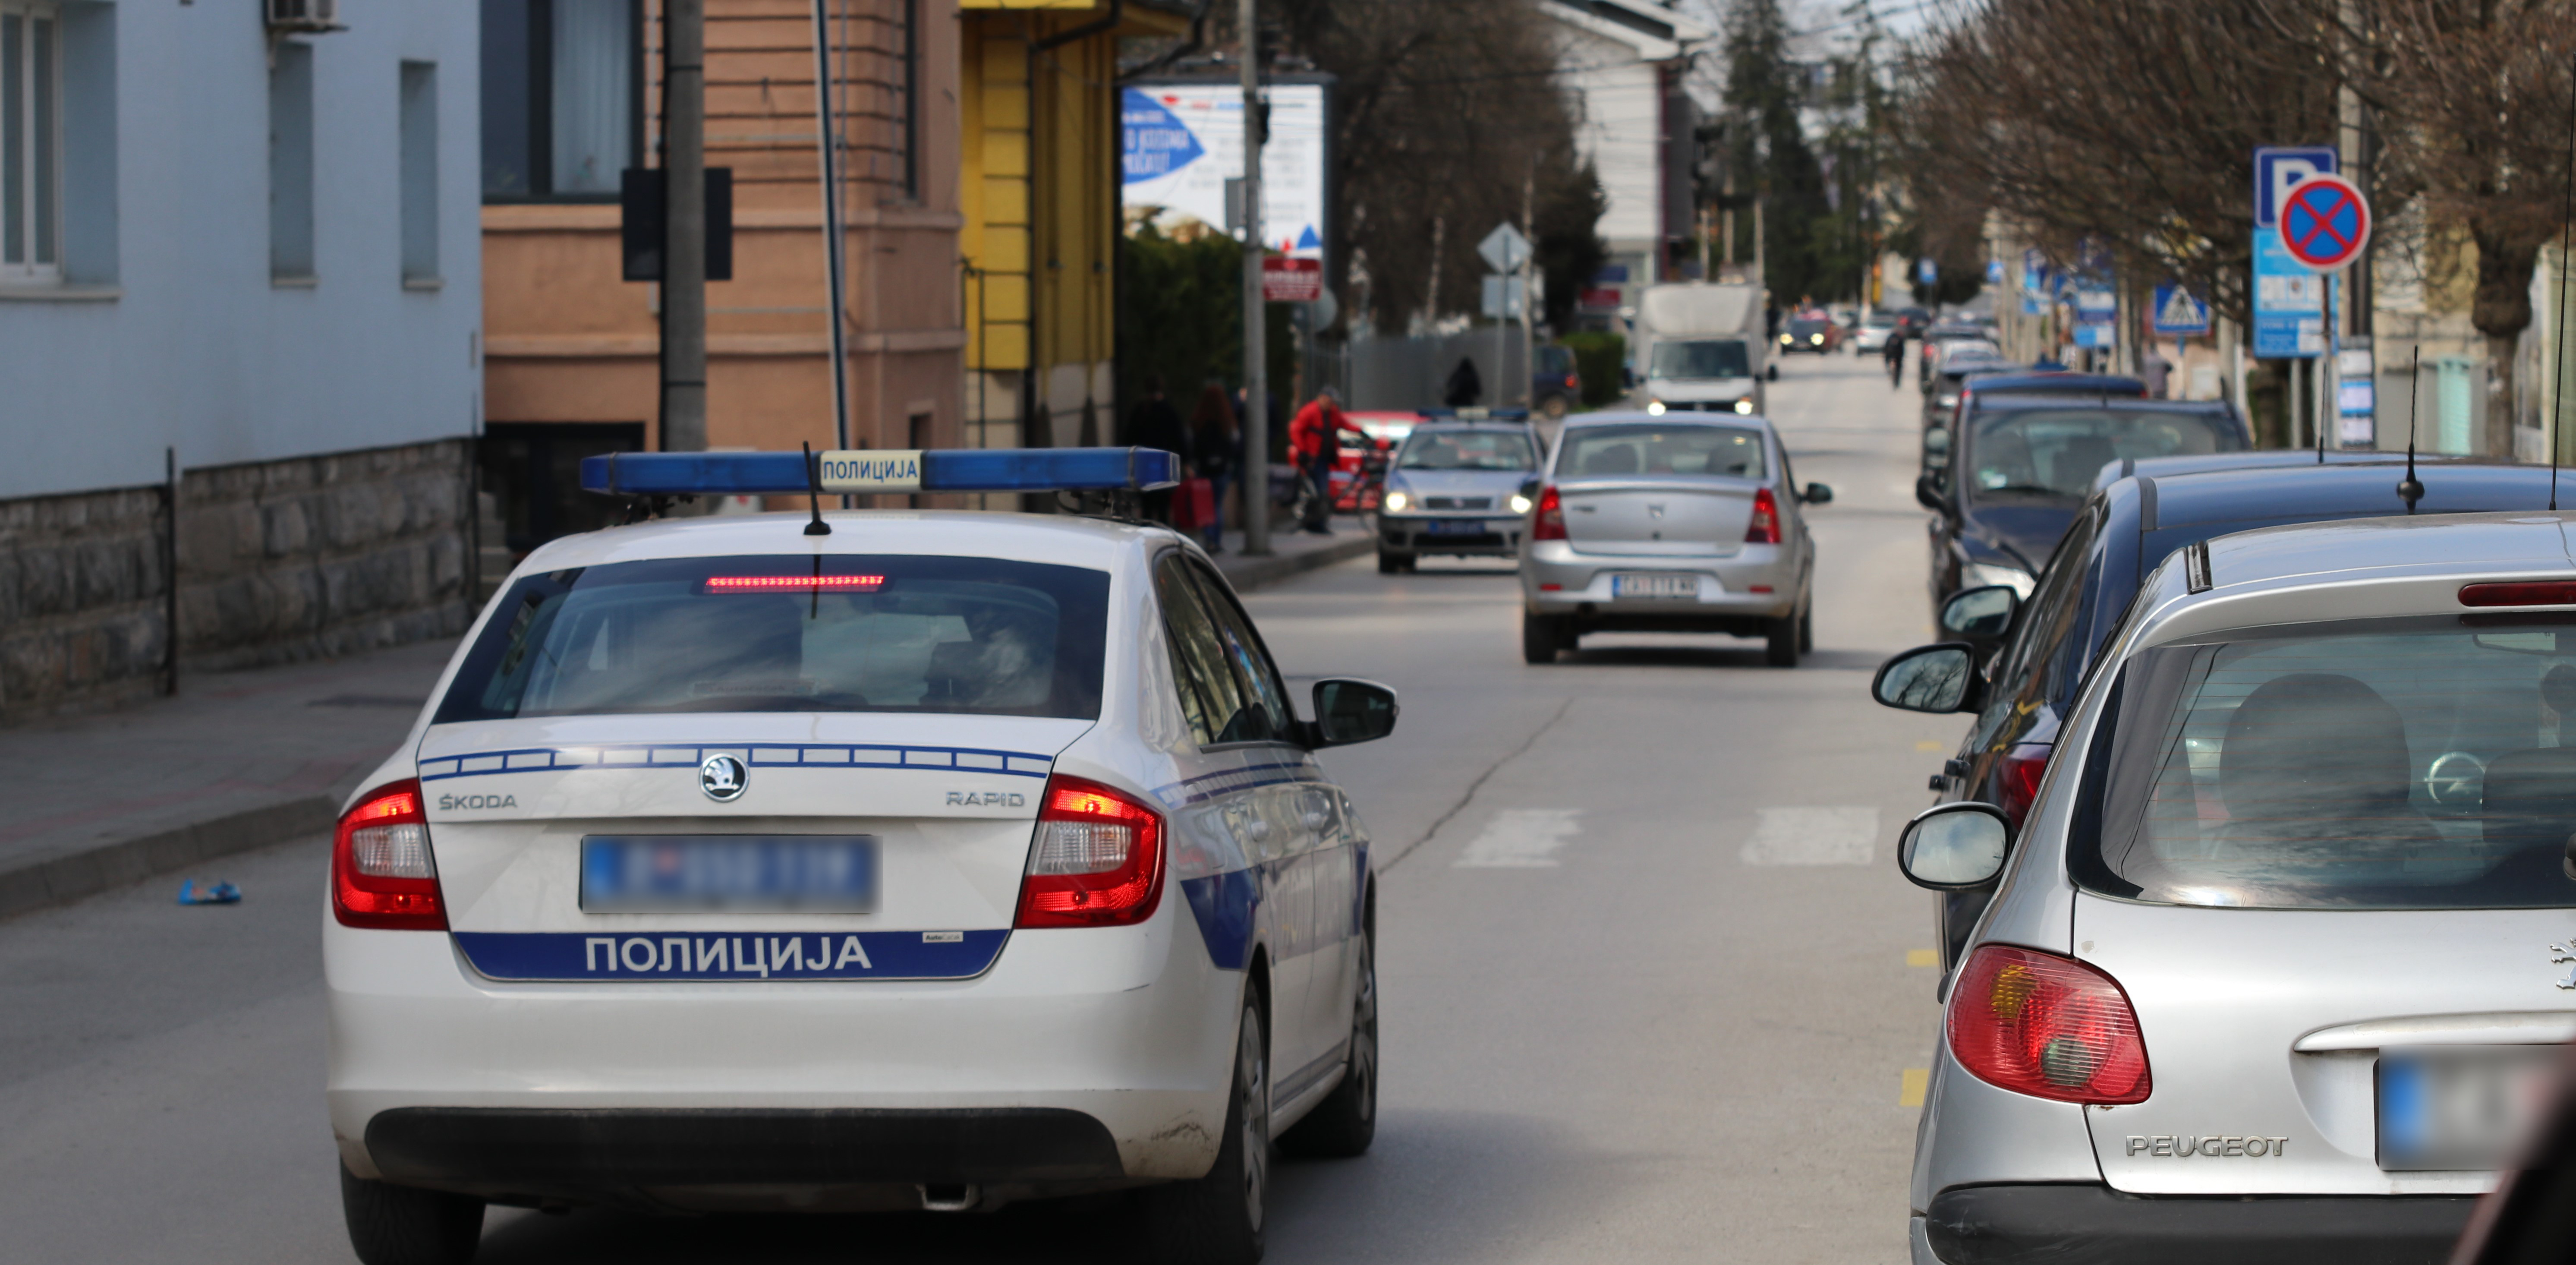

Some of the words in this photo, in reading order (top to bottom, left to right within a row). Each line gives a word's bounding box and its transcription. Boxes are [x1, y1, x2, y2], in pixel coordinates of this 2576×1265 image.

[2272, 158, 2317, 218] P
[824, 460, 917, 483] ПОЛИЦИЈА
[439, 793, 517, 810] ŠKODA
[946, 792, 1025, 806] RAPID
[586, 936, 872, 978] ПОЛИЦИЈА
[2126, 1136, 2289, 1157] PEUGEOT
